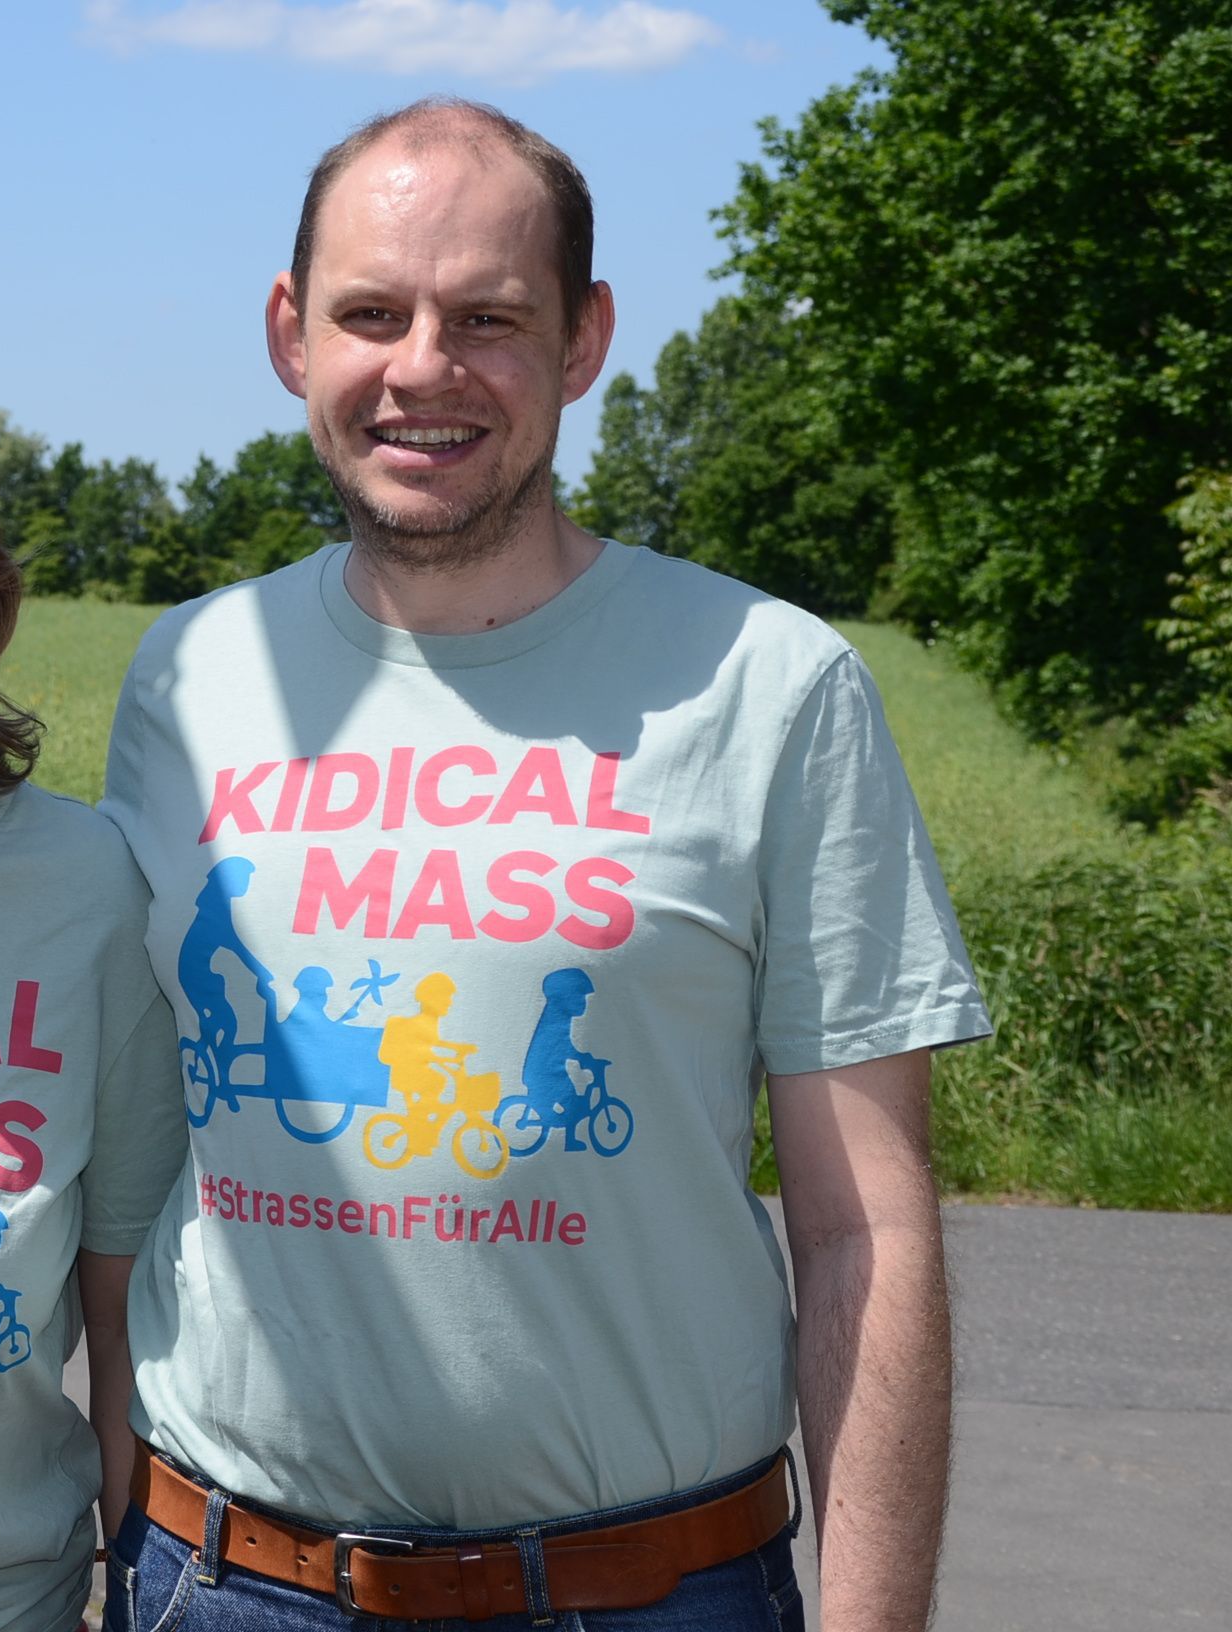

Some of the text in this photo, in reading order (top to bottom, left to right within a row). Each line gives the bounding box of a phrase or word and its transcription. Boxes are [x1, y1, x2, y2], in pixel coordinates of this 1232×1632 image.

[198, 745, 651, 845] KIDICAL
[292, 847, 636, 950] MASS
[200, 1174, 588, 1246] #StrassenFürAlle
